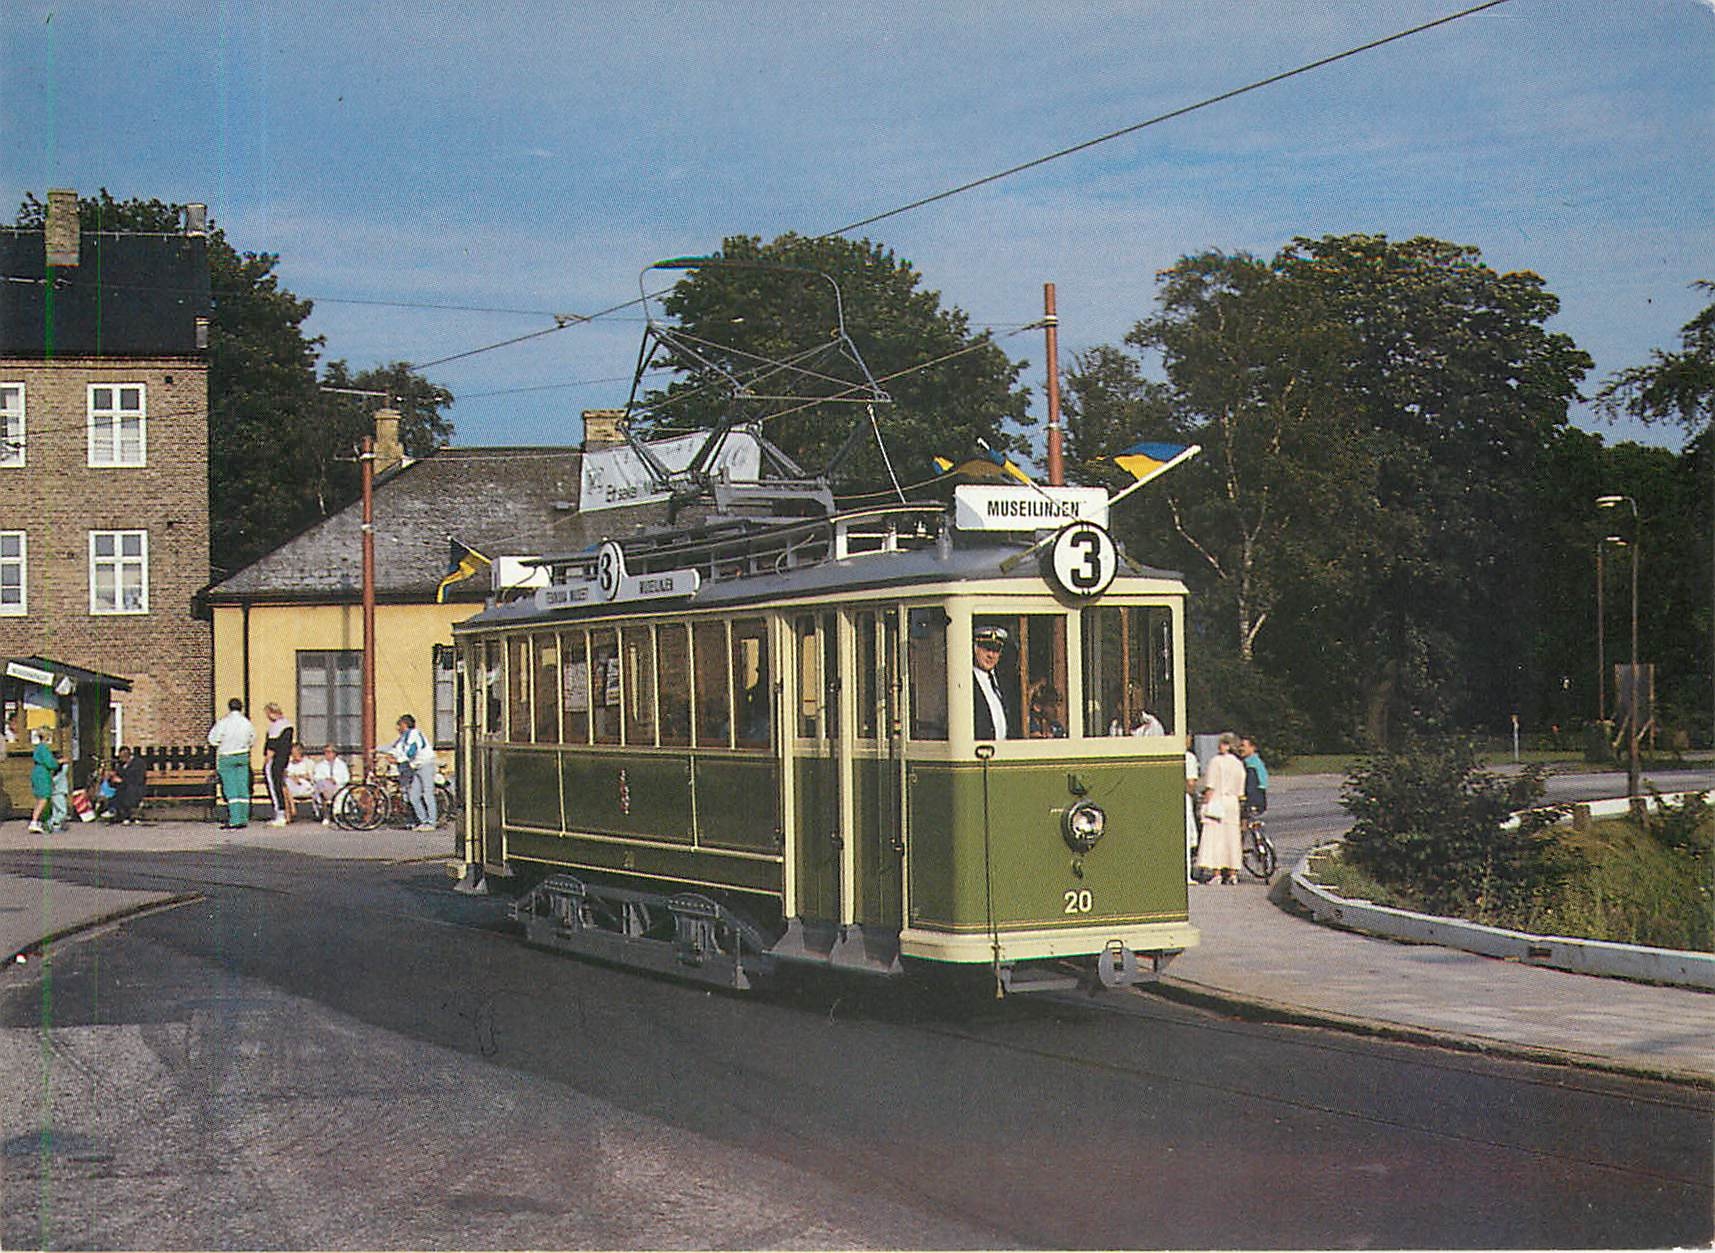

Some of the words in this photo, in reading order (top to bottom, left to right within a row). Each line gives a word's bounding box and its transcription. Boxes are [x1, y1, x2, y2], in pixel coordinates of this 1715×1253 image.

[987, 500, 1080, 518] MUSEILINJEN
[600, 552, 612, 591] 3
[1070, 530, 1102, 589] 3
[1064, 890, 1093, 914] 20
